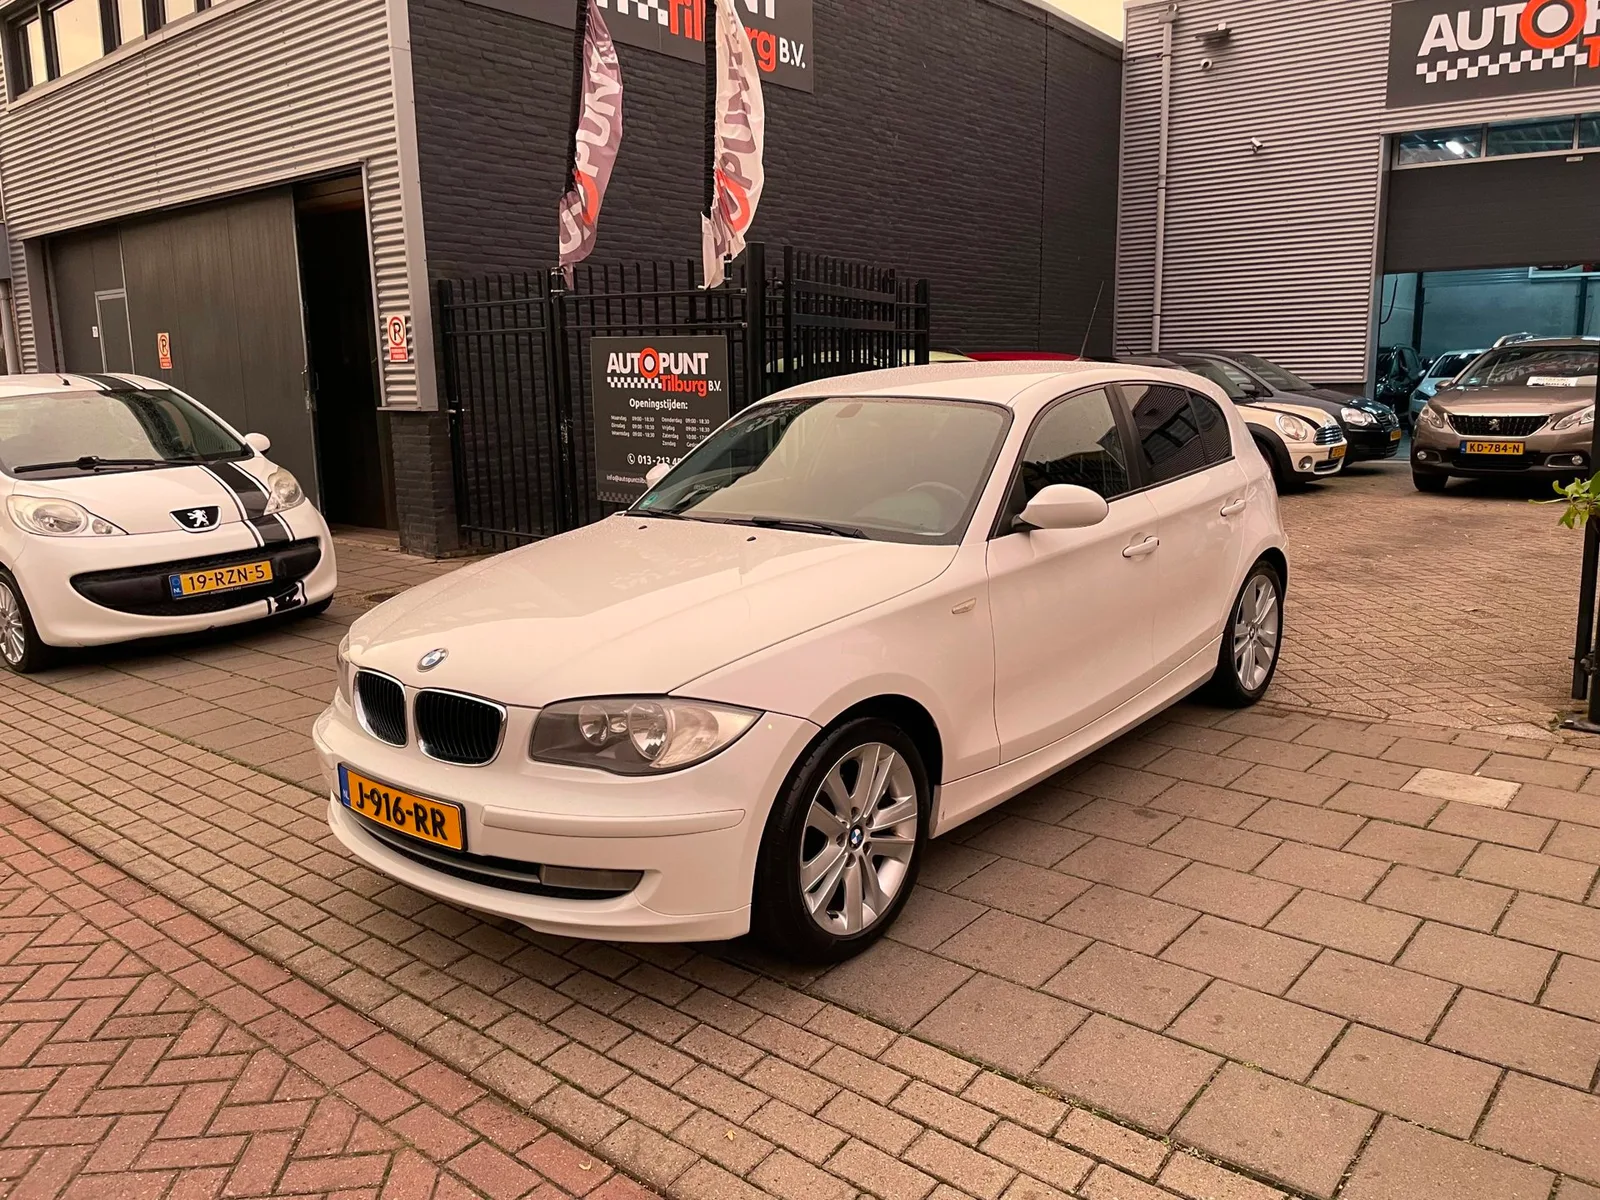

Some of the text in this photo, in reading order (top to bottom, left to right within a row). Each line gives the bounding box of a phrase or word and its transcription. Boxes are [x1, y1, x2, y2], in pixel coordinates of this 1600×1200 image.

[779, 37, 806, 69] B.V.
[606, 347, 709, 379] AUTOPUNT
[660, 374, 722, 397] Tilburg B.V.
[629, 398, 689, 411] Openingstijden:
[1469, 443, 1520, 453] KD-784-N
[189, 565, 265, 591] 19-RZN-5
[356, 782, 448, 841] J-916-RR
